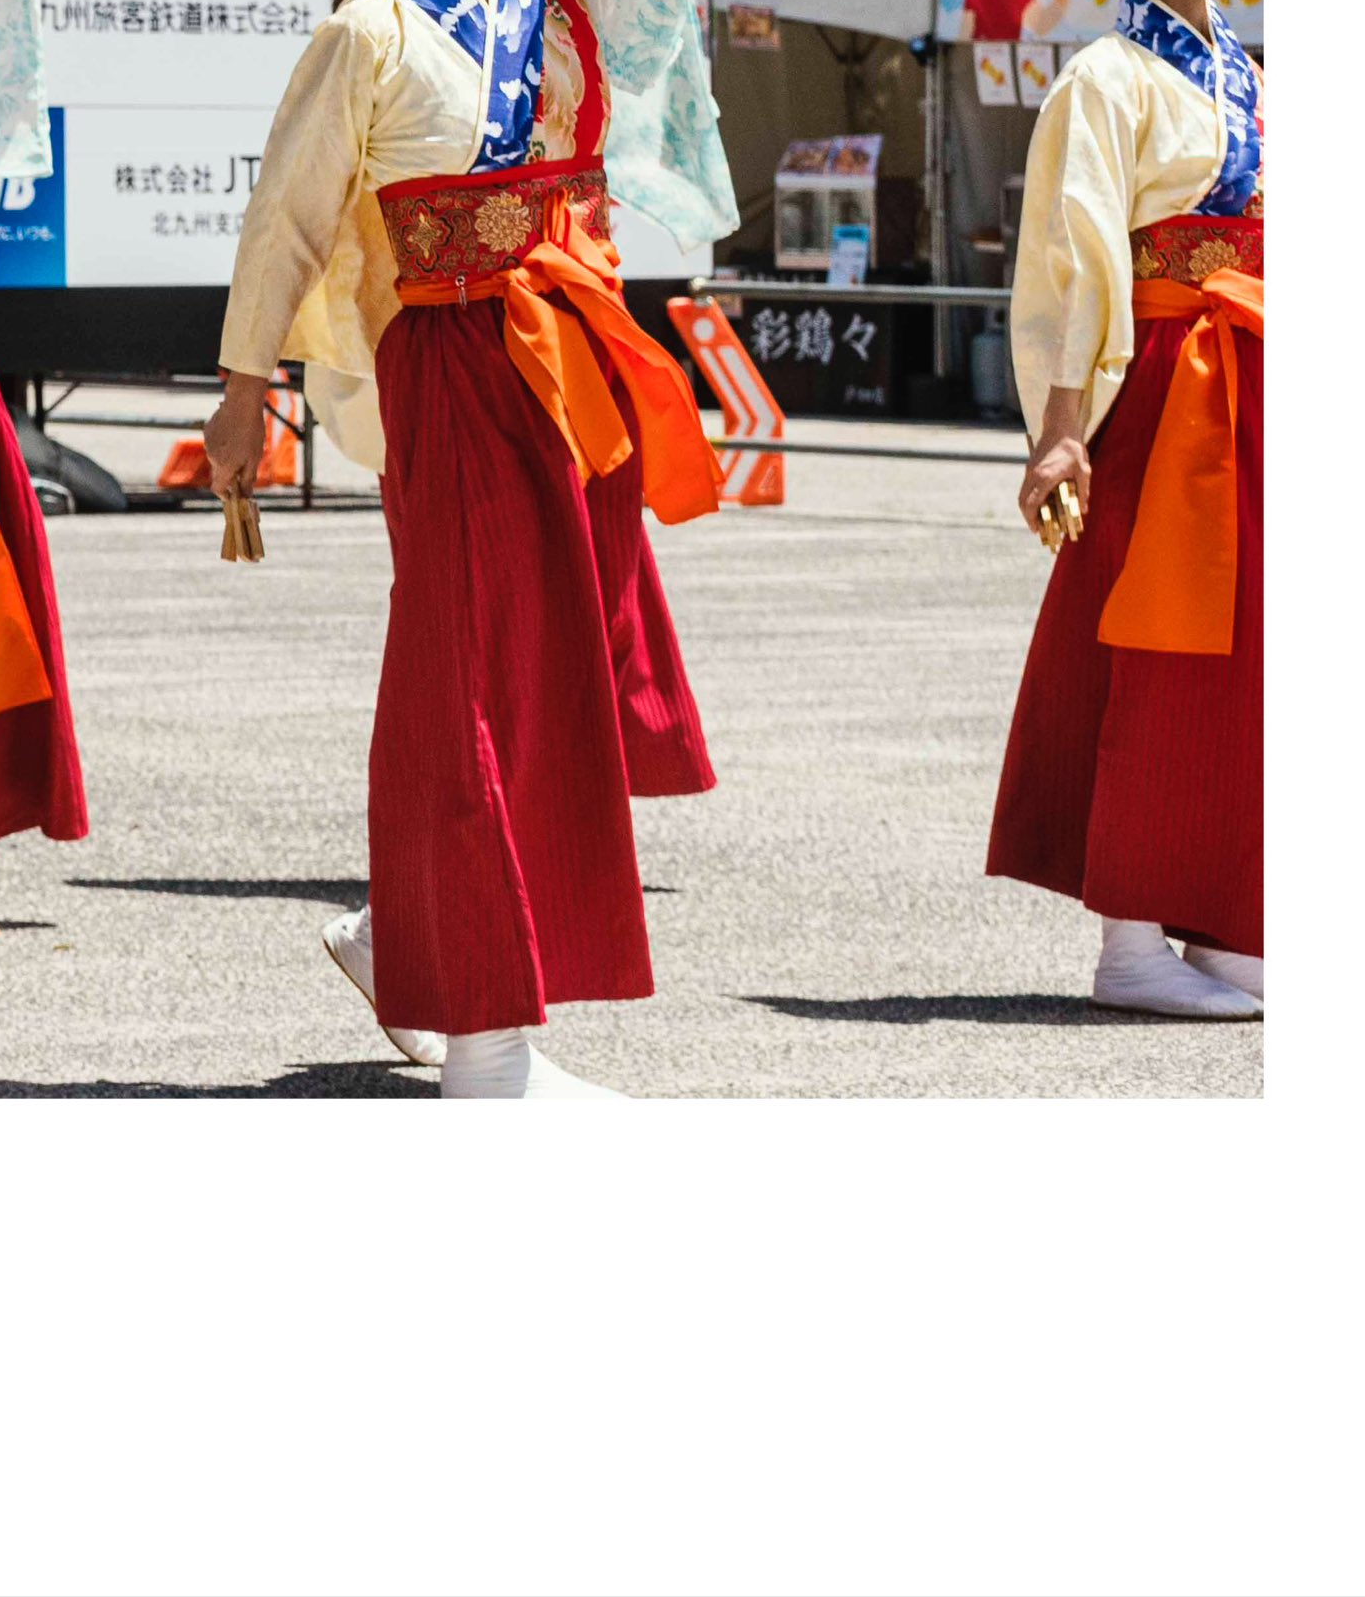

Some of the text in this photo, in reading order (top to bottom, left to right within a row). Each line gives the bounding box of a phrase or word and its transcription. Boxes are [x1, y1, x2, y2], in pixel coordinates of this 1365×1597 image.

[40, 0, 312, 34] 九州旅客鉄道株式会社
[115, 164, 212, 194] 株式会社
[752, 308, 878, 363] 彩鶏々
